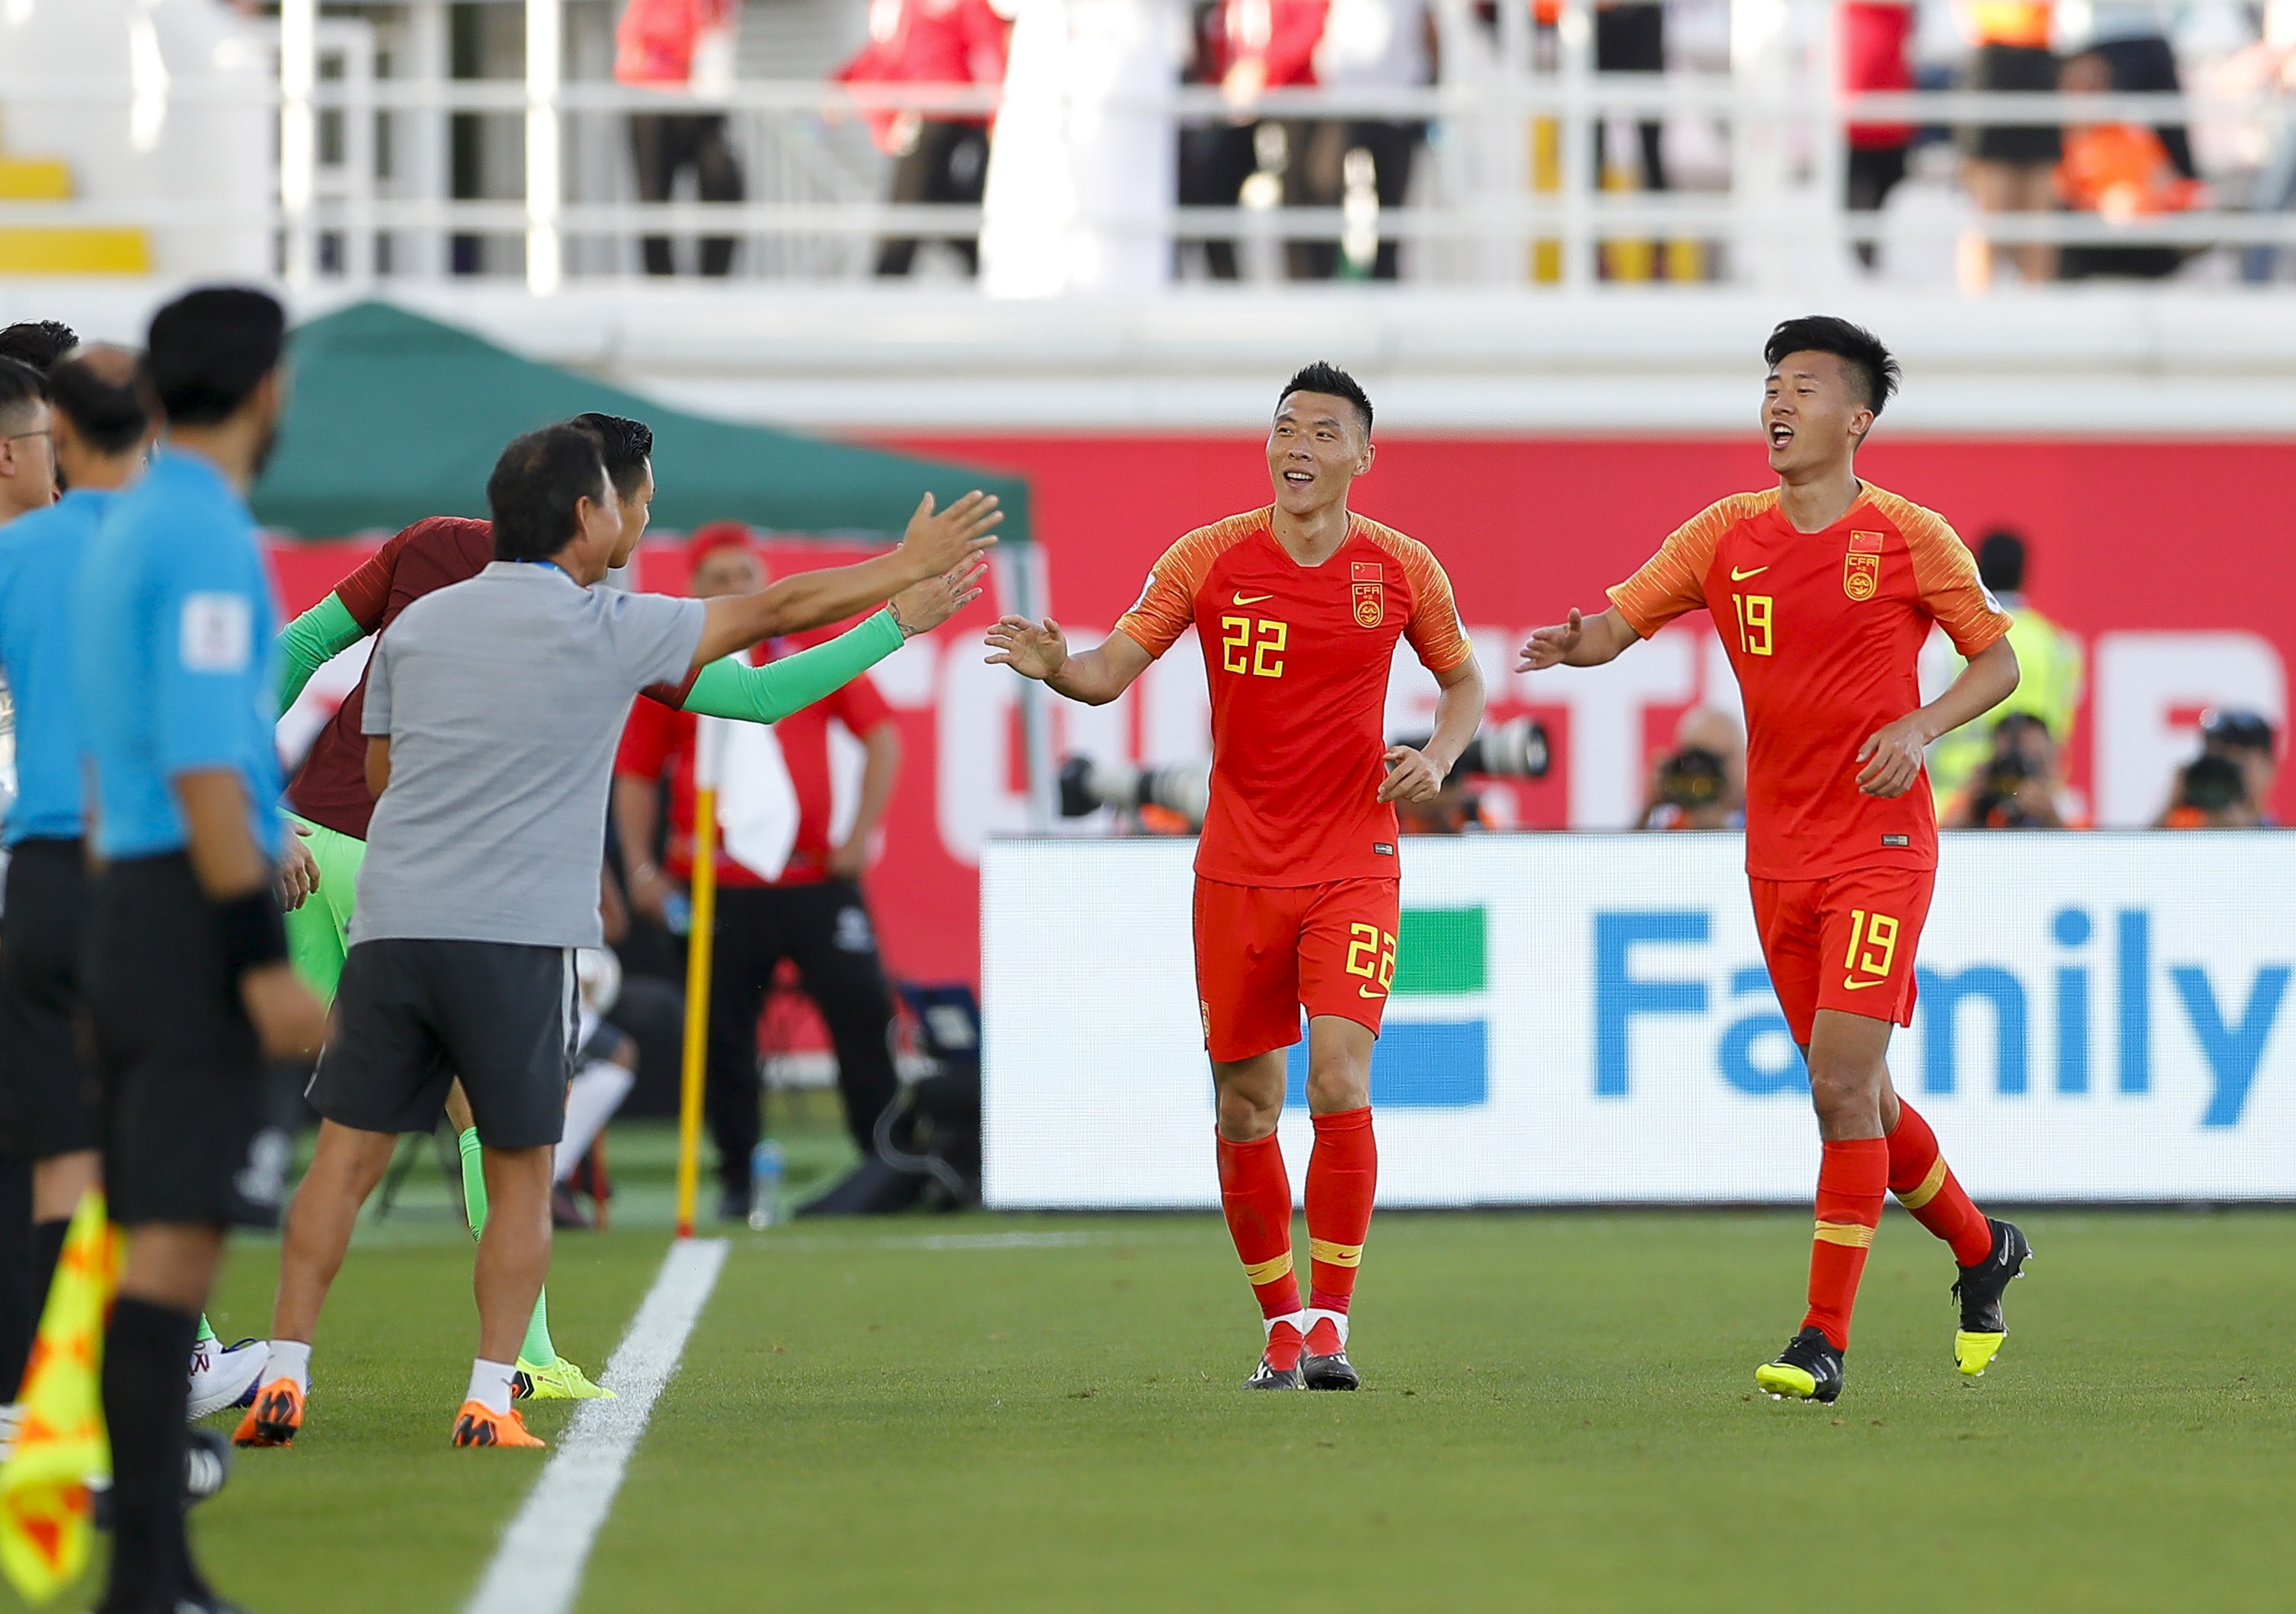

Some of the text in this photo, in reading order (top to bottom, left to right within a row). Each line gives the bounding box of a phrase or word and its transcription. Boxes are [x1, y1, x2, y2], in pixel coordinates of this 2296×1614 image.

[1355, 586, 1380, 595] CFA
[1848, 556, 1876, 567] CFA
[1221, 615, 1288, 678] 22
[1731, 593, 1774, 657] 19
[1345, 921, 1397, 992] 22
[1844, 909, 1900, 977] 19
[1593, 906, 2293, 1126] Family
